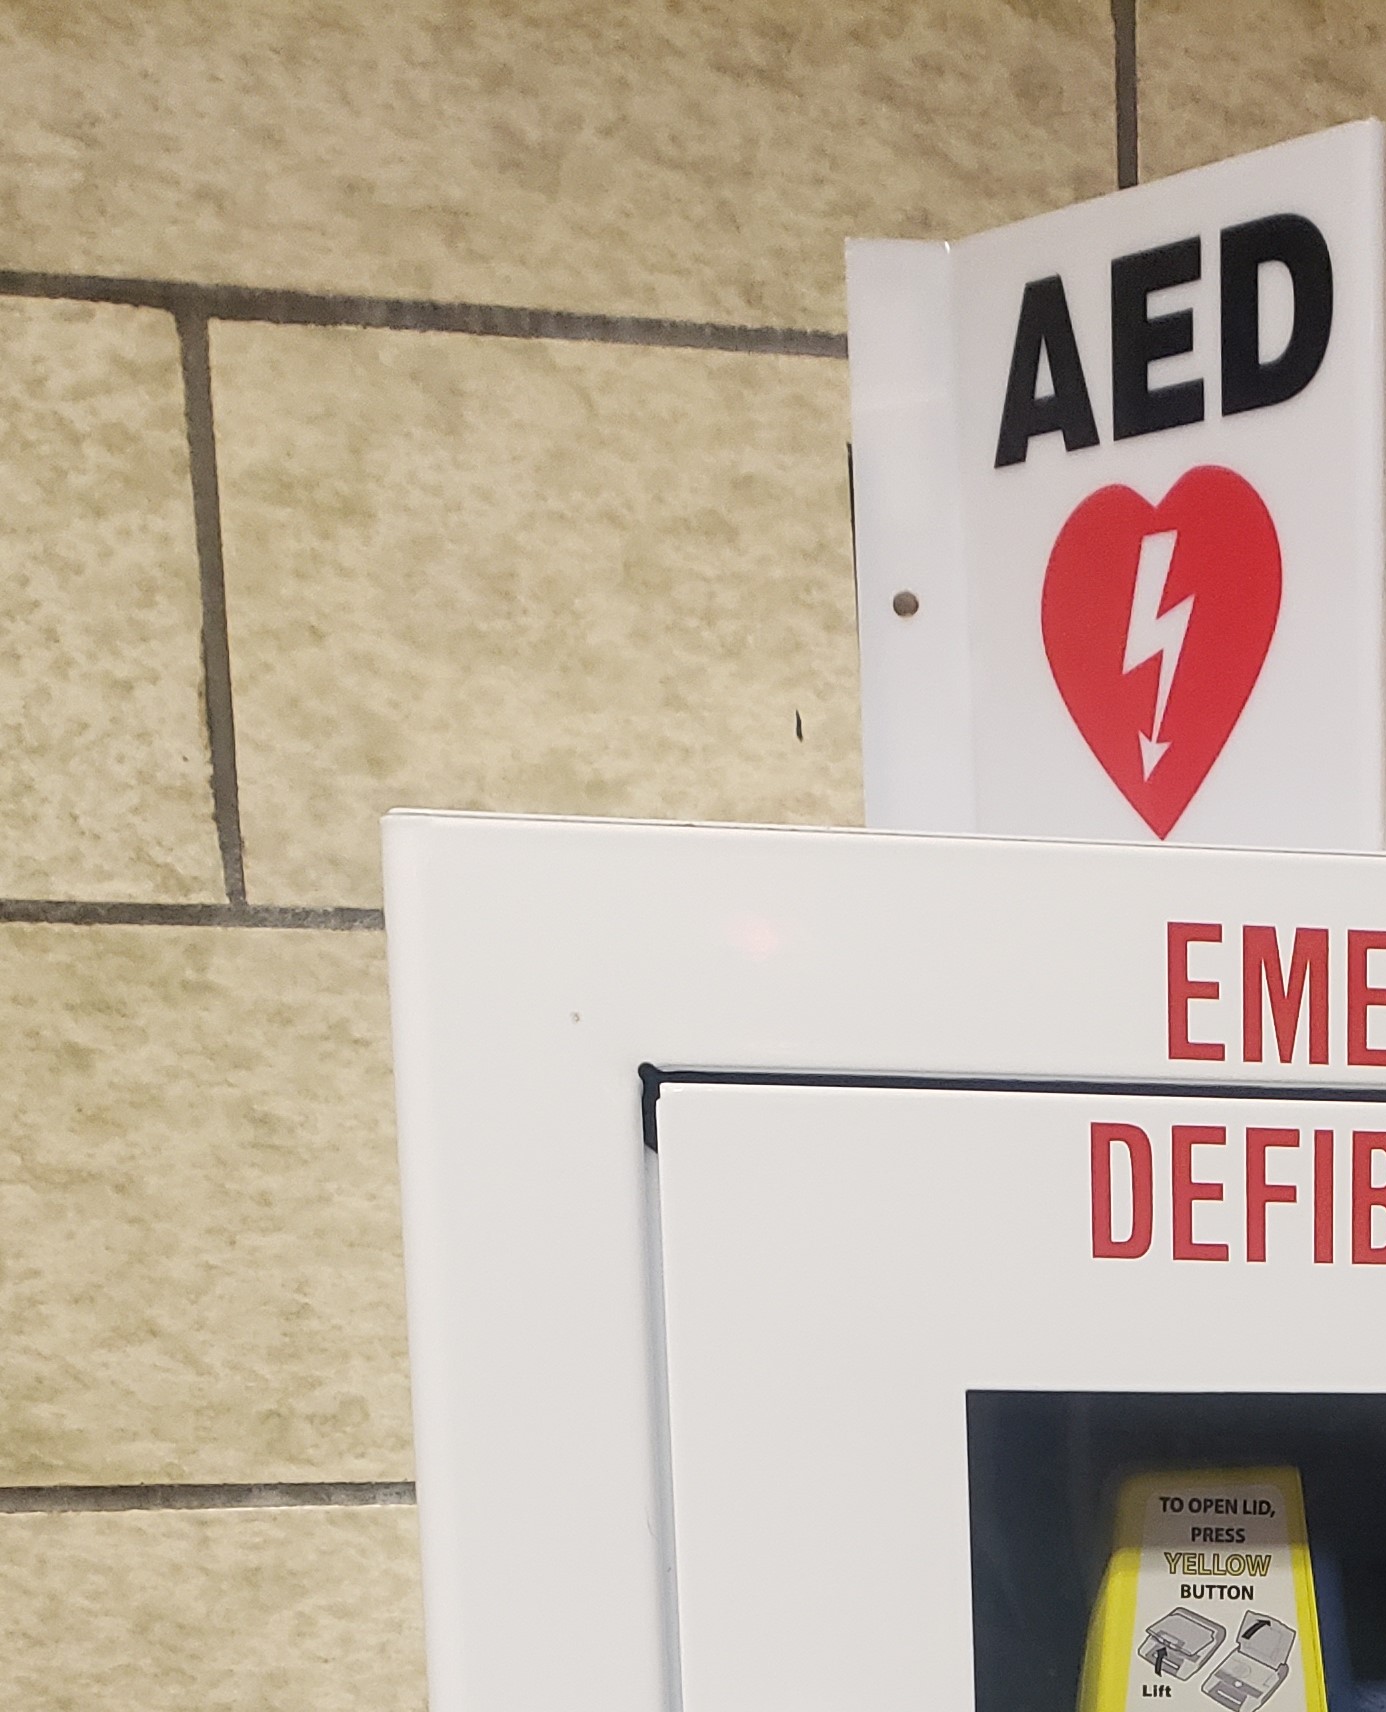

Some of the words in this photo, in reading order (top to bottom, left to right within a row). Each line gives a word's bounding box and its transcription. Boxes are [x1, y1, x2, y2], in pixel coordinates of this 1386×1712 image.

[994, 212, 1334, 470] AED
[1159, 1496, 1184, 1514] TO
[1188, 1497, 1239, 1516] OPEN
[1242, 1498, 1276, 1518] LID,
[1190, 1526, 1246, 1544] PRESS
[1163, 1551, 1272, 1577] YELLOW
[1180, 1583, 1255, 1601] BUTTON
[1142, 1684, 1172, 1698] Lift
